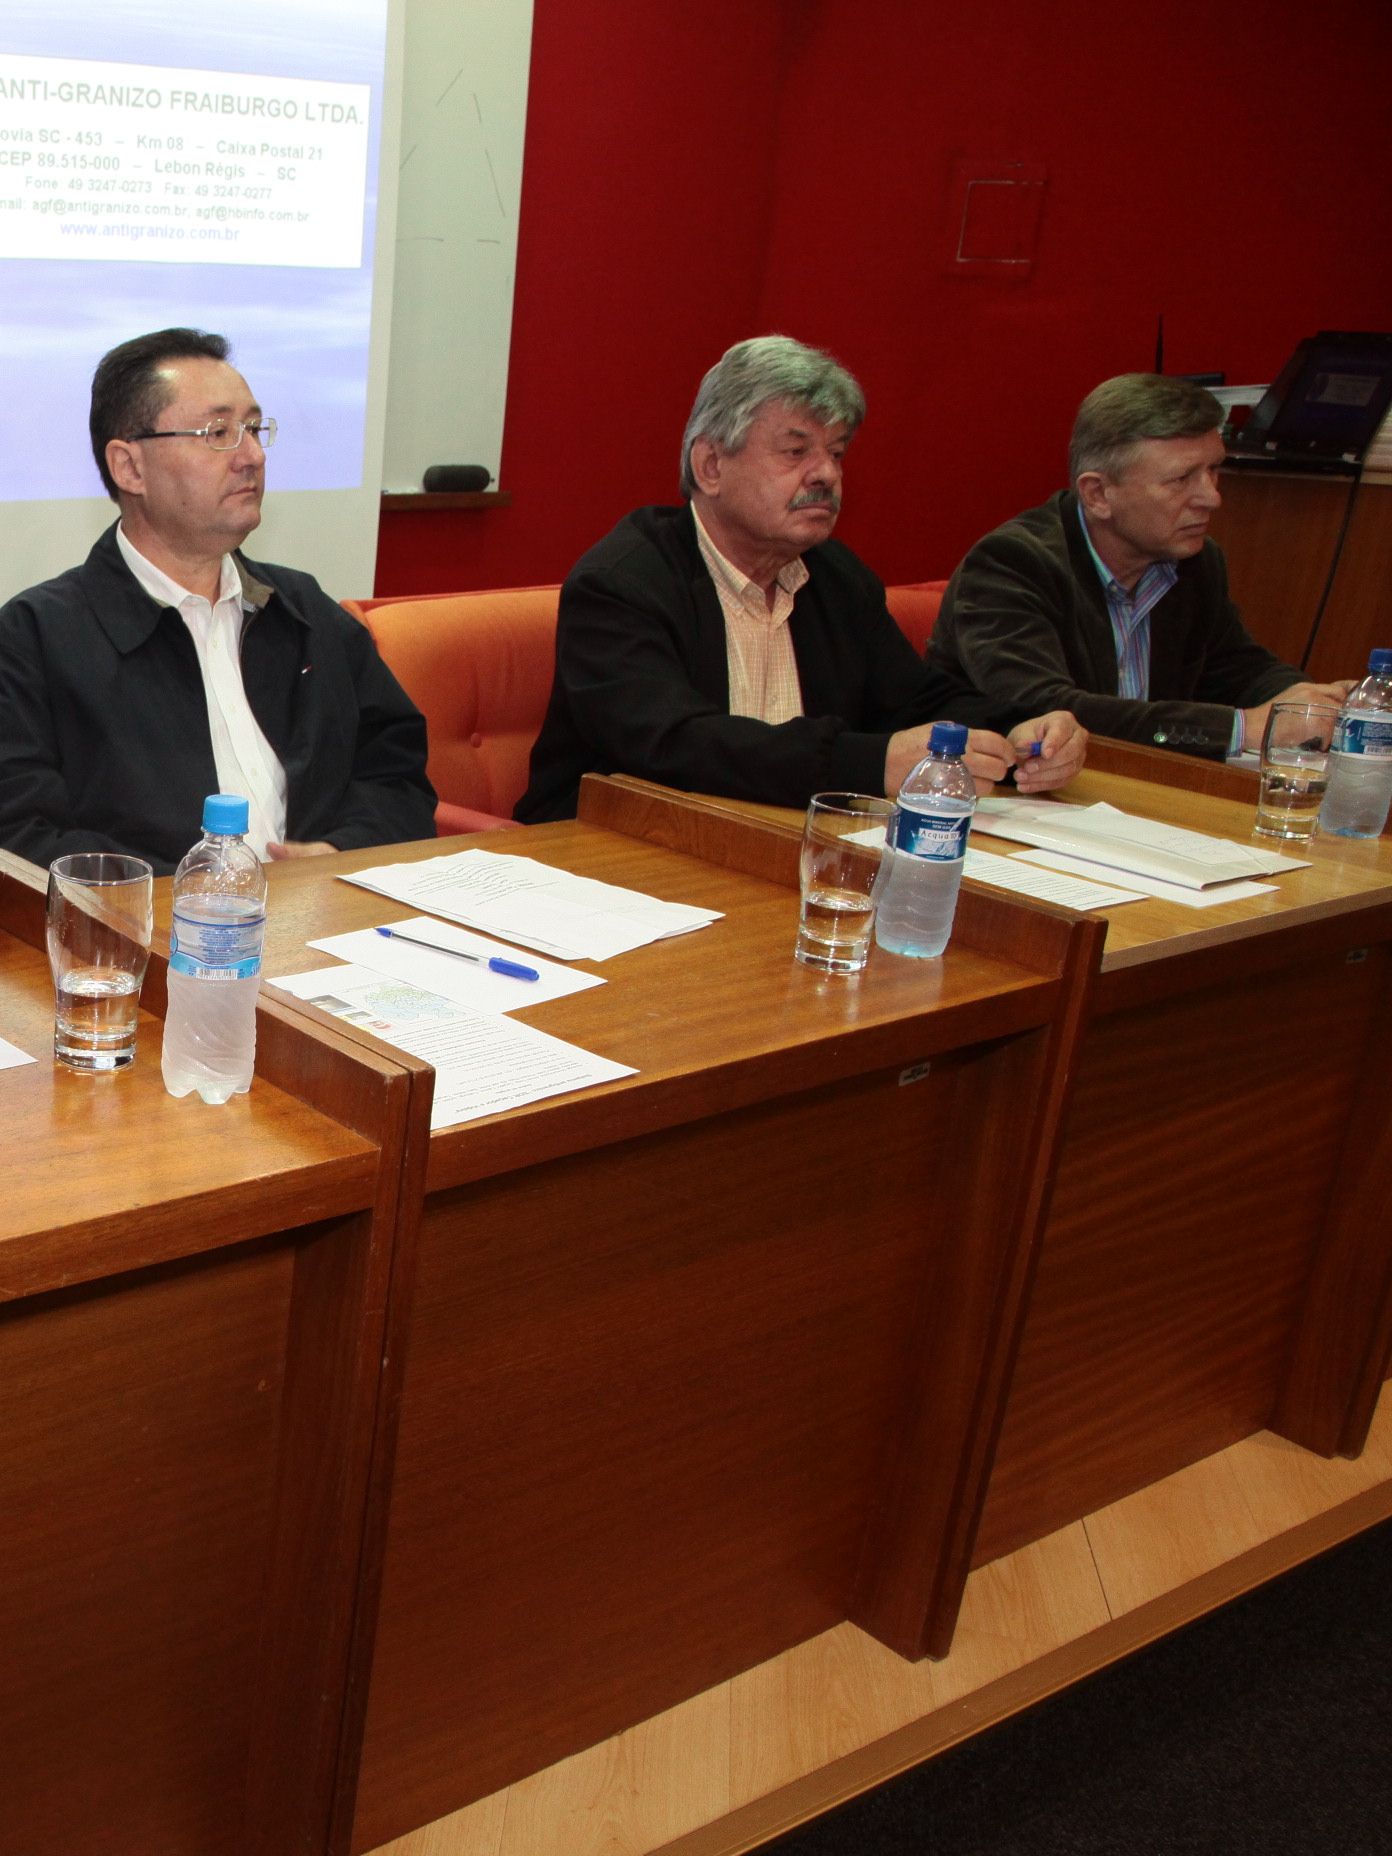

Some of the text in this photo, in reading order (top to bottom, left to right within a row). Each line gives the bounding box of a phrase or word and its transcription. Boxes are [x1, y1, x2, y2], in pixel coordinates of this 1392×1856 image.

[170, 90, 298, 119] FRAIBURGO
[305, 101, 365, 125] LTDA.
[38, 128, 61, 144] SC
[75, 131, 103, 147] 453
[136, 135, 162, 150] Km
[166, 136, 184, 151] 08
[216, 139, 257, 156] Caixa
[260, 143, 304, 159] Postal
[308, 146, 323, 161] 21
[37, 152, 121, 171] 89.515-000
[154, 158, 201, 176] Lebon
[205, 161, 246, 181] Régis
[276, 166, 297, 181] SC
[25, 176, 63, 190] Fone:
[68, 178, 84, 191] 49
[164, 182, 190, 195] Fax:
[194, 184, 209, 197] 49
[60, 223, 241, 241] www.antigranizo.com.br
